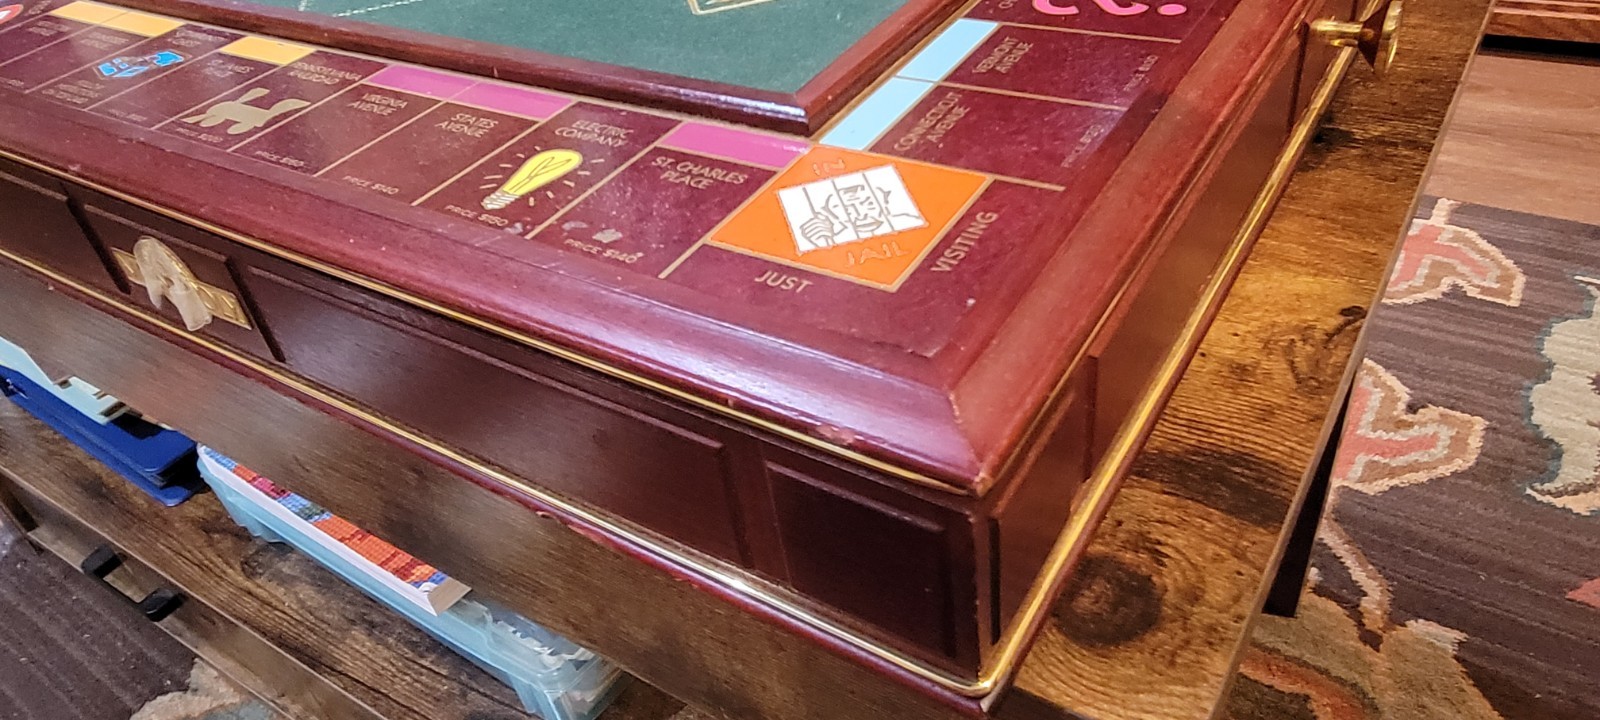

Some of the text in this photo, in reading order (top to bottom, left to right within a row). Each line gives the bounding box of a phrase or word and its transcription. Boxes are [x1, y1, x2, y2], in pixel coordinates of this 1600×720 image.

[971, 36, 1019, 73] VERMONT
[994, 41, 1034, 74] AVENUE
[347, 101, 398, 116] AVENUE
[361, 93, 408, 108] VIRGINIA
[434, 121, 489, 139] AVENUE
[450, 112, 499, 129] STATES
[571, 119, 634, 139] ELECTRIC
[893, 91, 962, 151] CONNECTICUT
[926, 105, 971, 143] AVENUE
[554, 127, 629, 148] COMPANY
[651, 156, 749, 185] ST. CHARLES
[812, 158, 846, 177] IN
[341, 175, 399, 195] PRICE $140
[660, 170, 714, 190] PLACE
[445, 204, 509, 227] PRICE $150
[564, 238, 602, 254] PRICE
[930, 210, 999, 275] VISITING
[847, 241, 910, 267] JAIL
[754, 270, 813, 294] JUST
